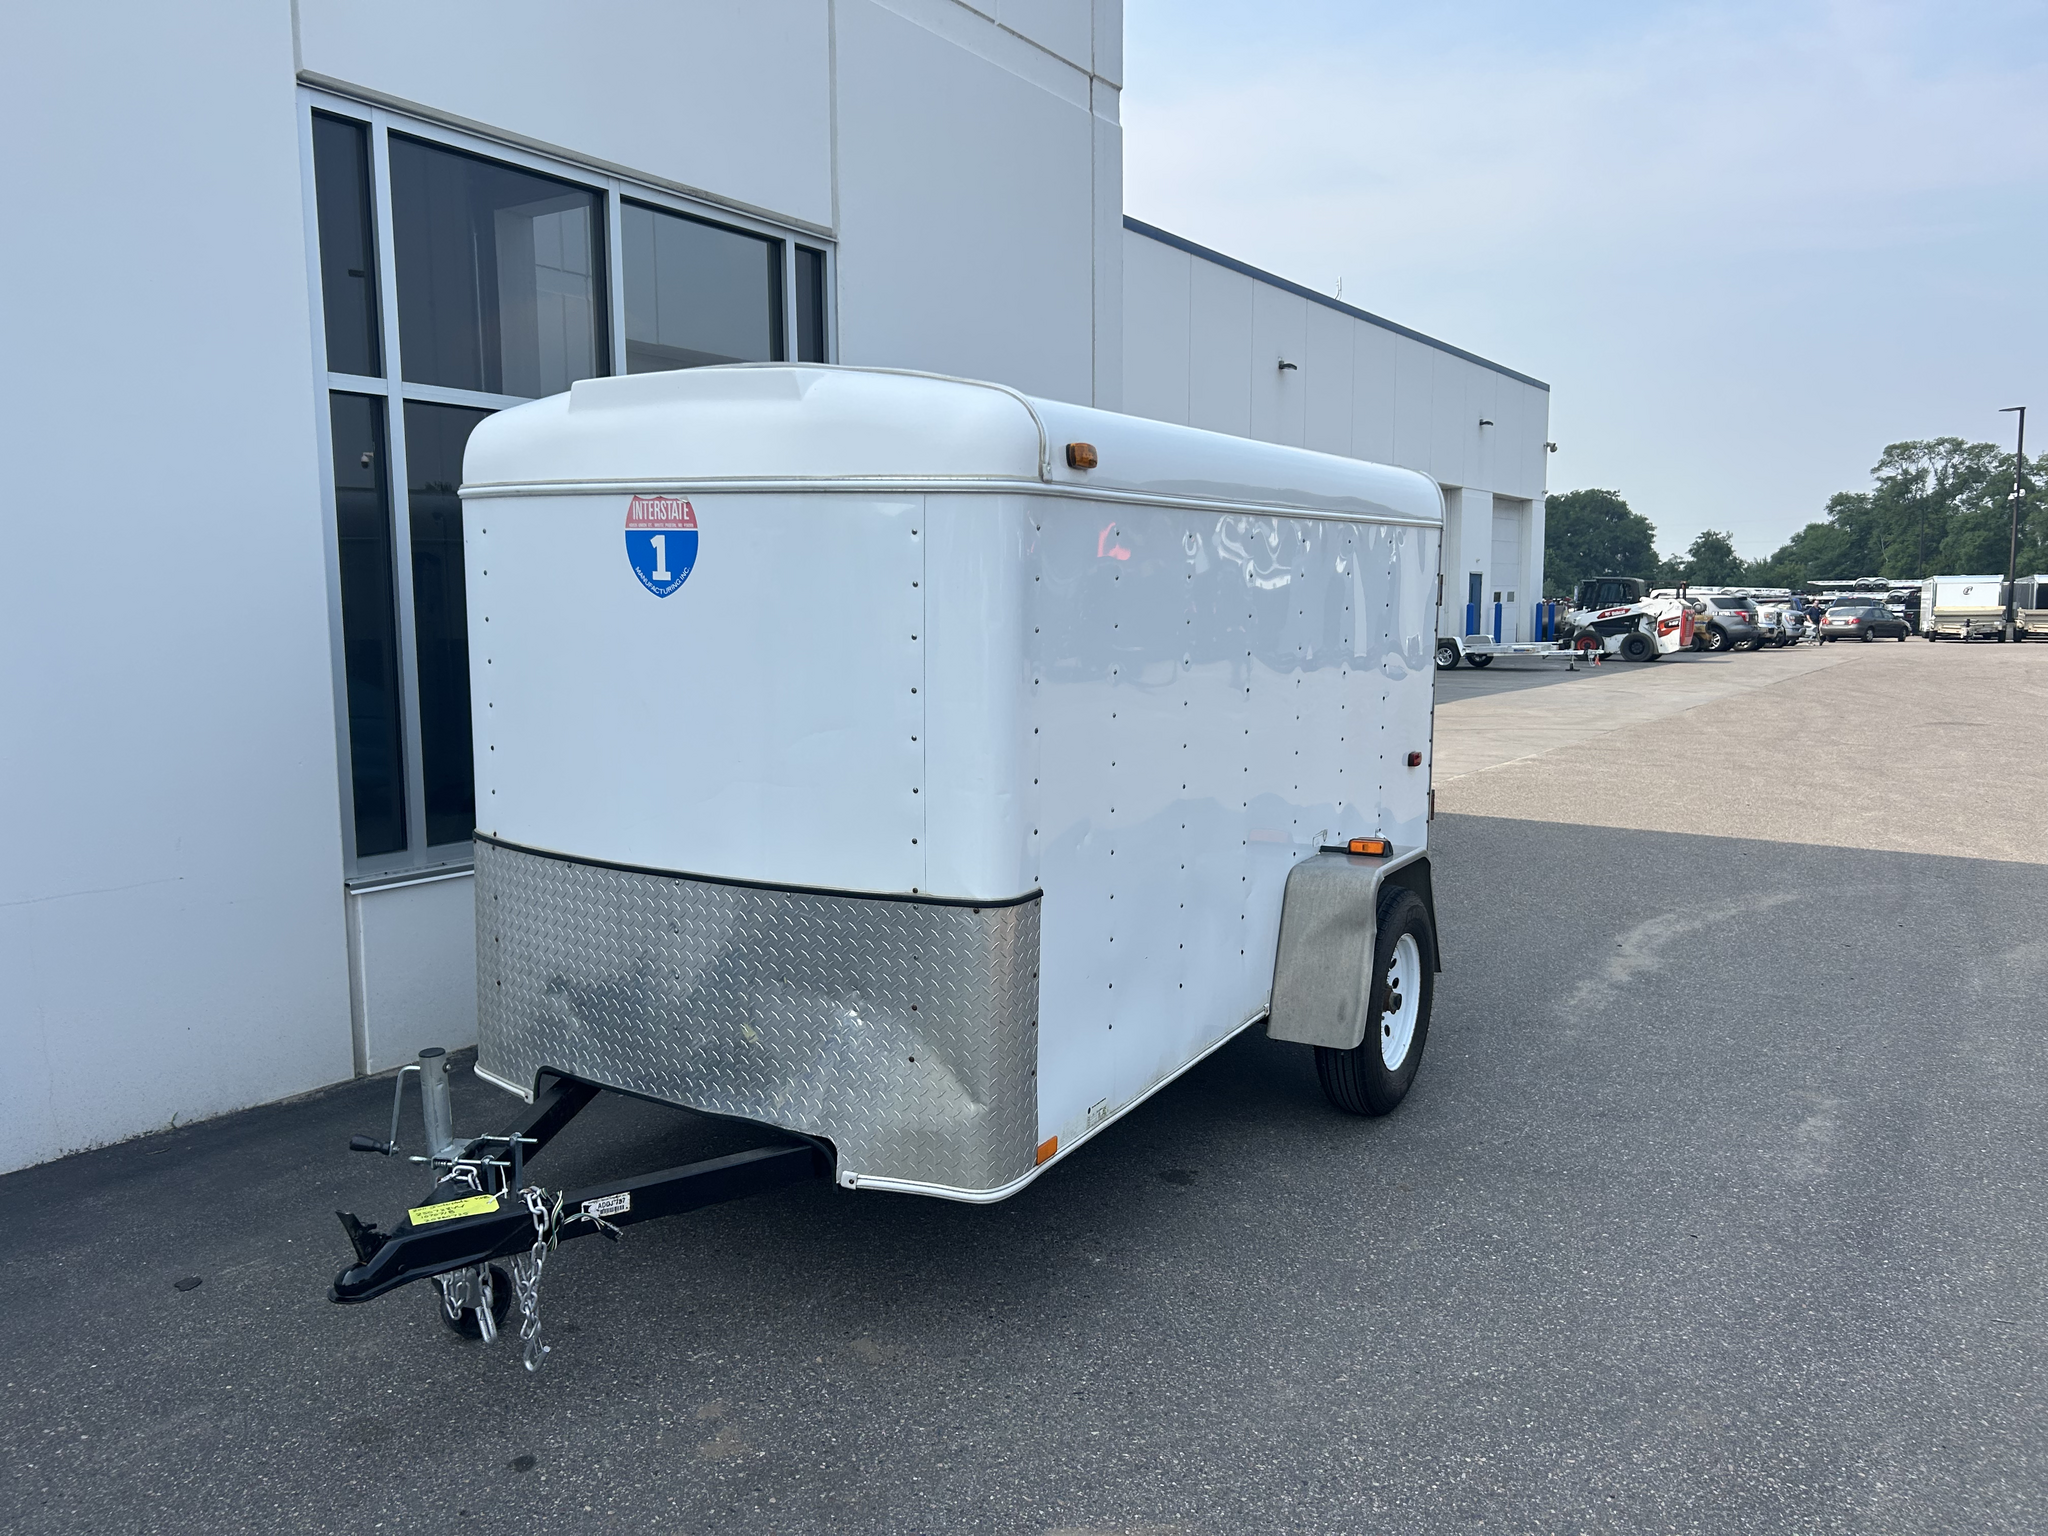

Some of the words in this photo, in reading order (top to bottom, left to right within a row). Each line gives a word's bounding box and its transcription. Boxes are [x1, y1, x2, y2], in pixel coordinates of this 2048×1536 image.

[632, 500, 690, 520] INTERSTATE
[650, 534, 672, 581] 1
[635, 566, 682, 595] MANUFACTURING
[679, 566, 691, 581] INC.
